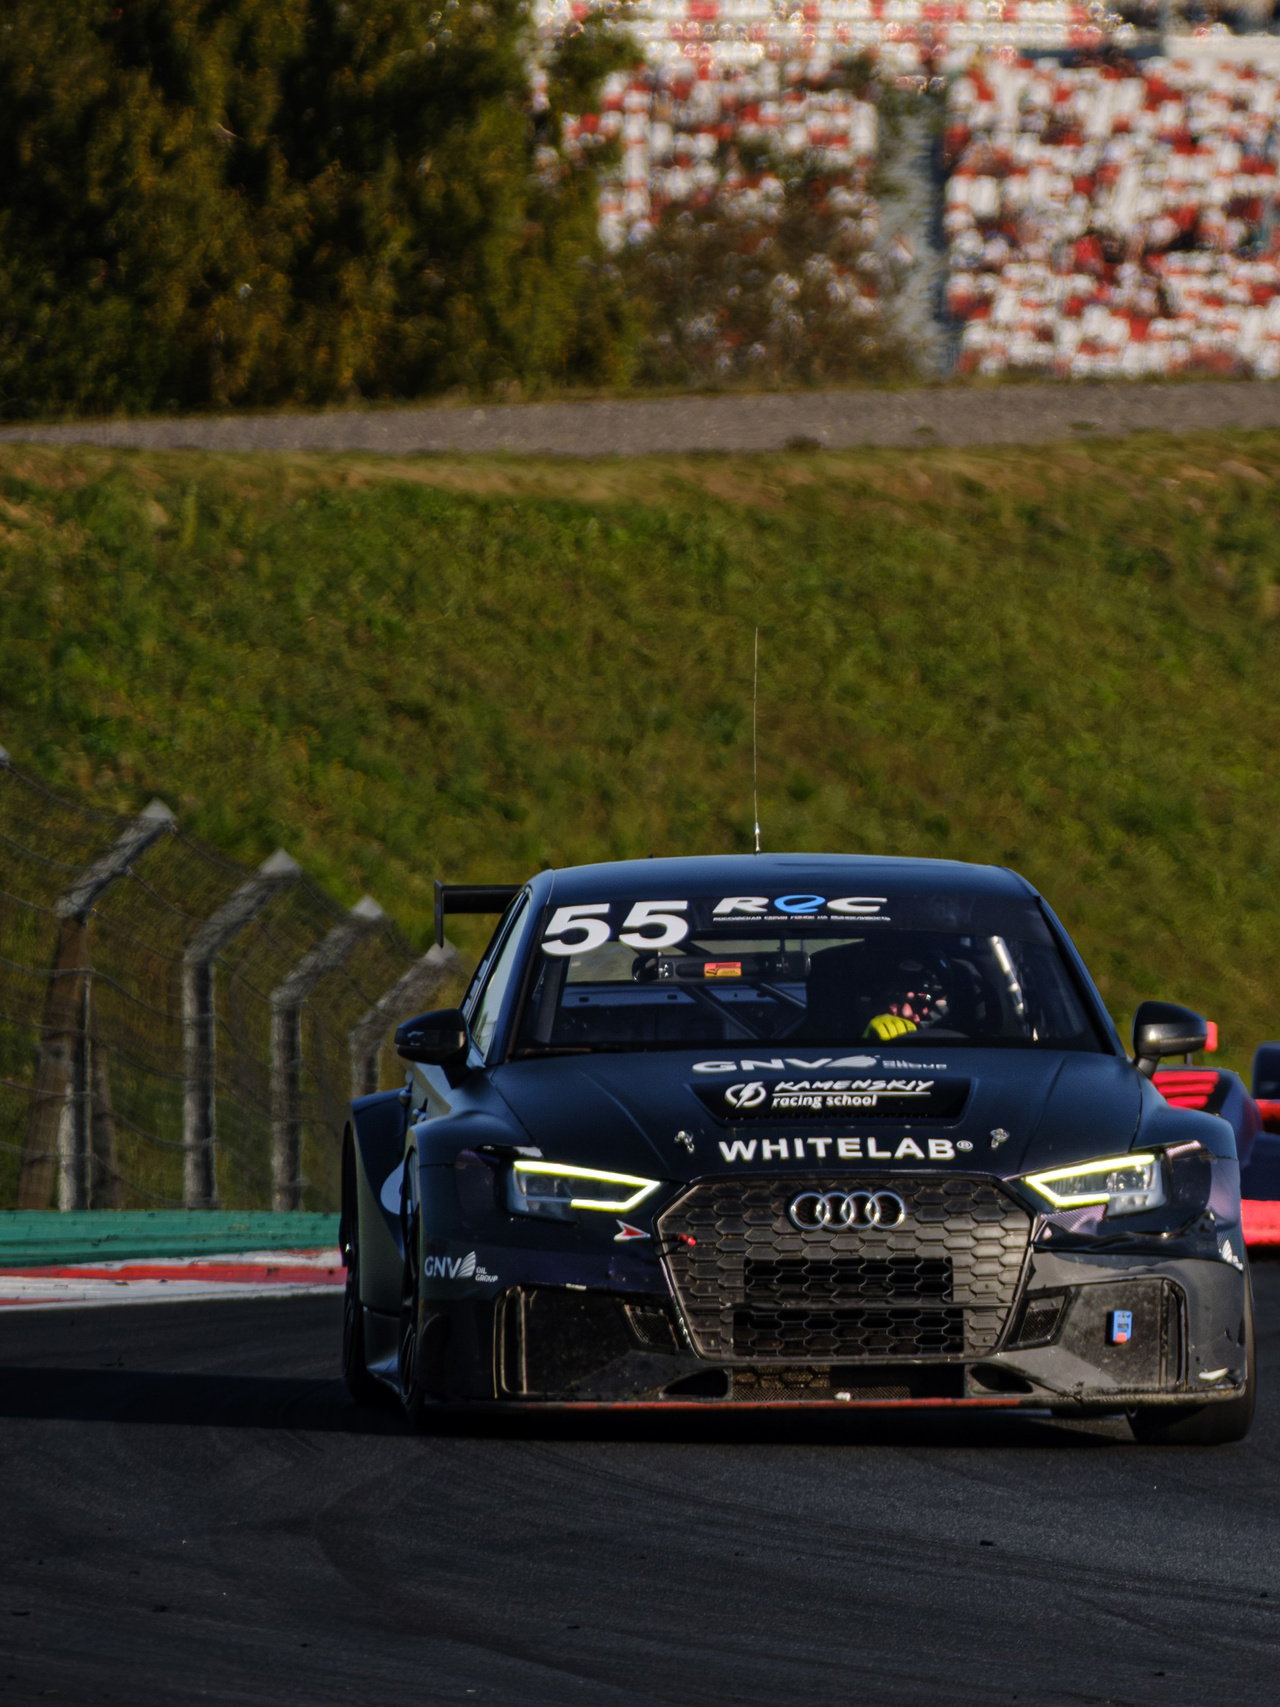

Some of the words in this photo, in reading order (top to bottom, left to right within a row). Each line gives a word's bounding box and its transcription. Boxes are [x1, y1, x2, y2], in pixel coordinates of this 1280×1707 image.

[541, 900, 689, 956] 55
[692, 1057, 832, 1073] GNV
[773, 1079, 935, 1092] KAMENSKIY
[771, 1094, 822, 1110] racing
[825, 1093, 878, 1108] school
[424, 1255, 462, 1279] GNV
